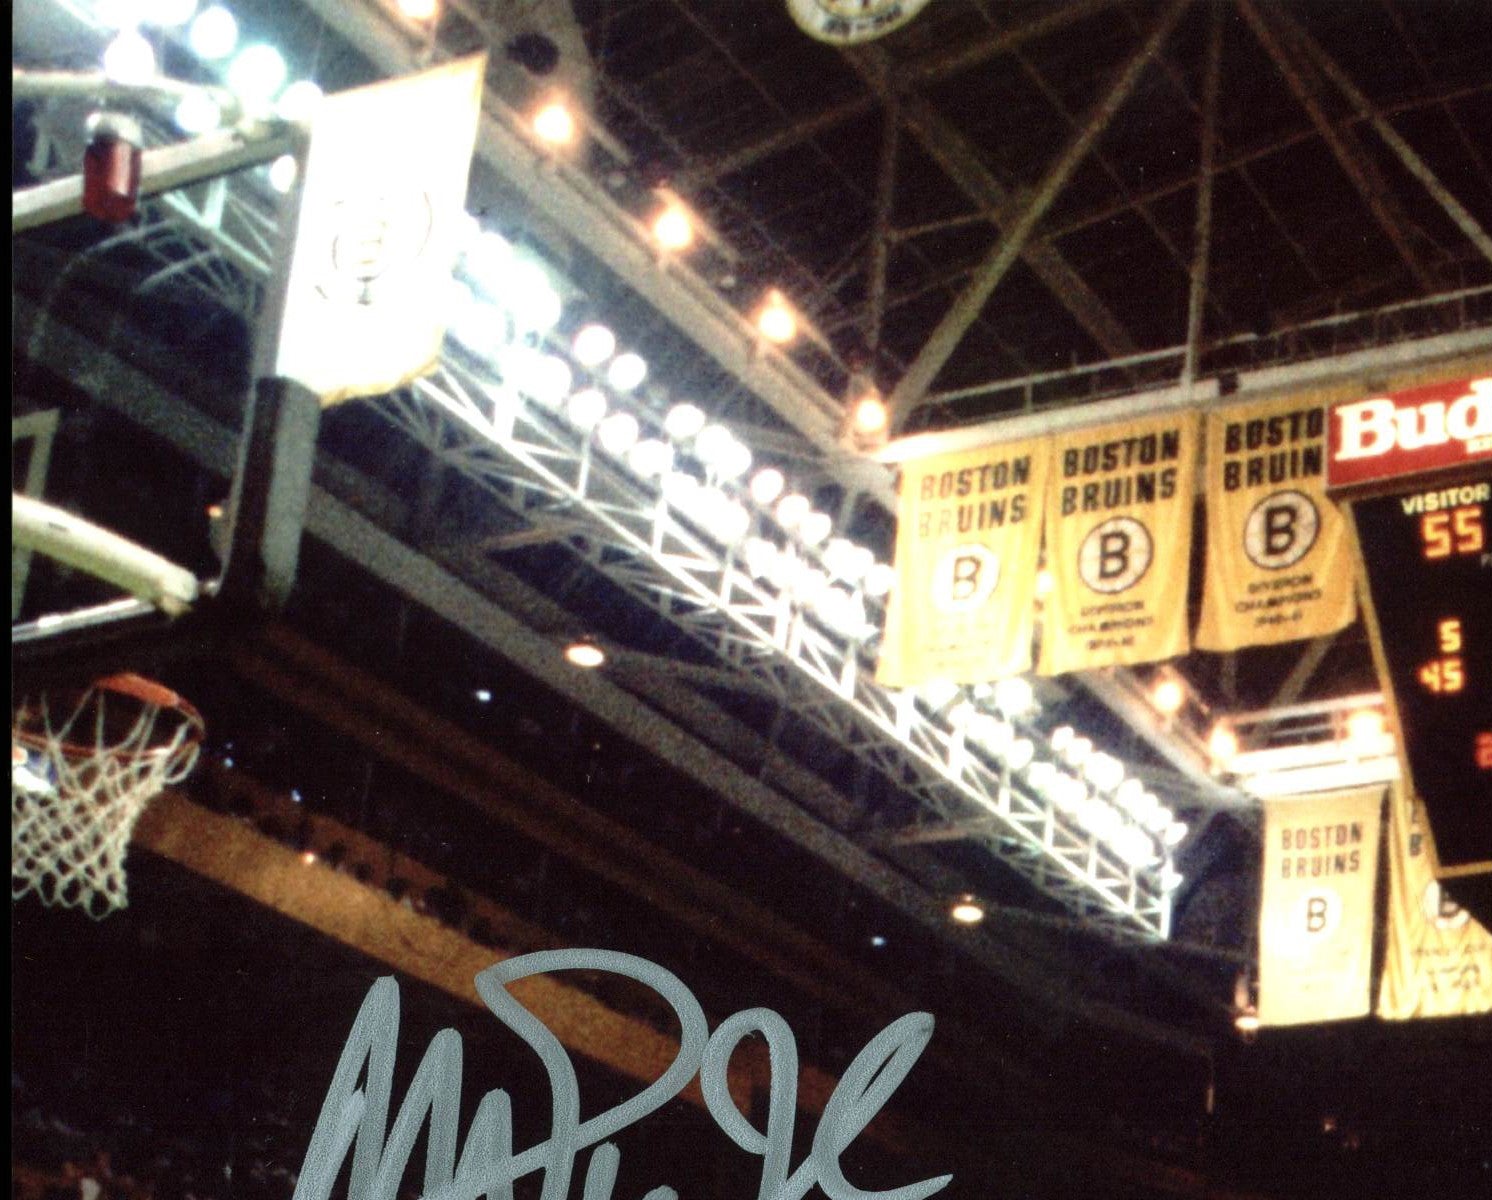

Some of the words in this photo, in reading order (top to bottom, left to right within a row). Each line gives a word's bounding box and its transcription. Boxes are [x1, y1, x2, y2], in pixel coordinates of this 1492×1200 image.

[1225, 408, 1324, 454] BOSTO
[1063, 429, 1180, 478] BOSTON
[1224, 446, 1321, 492] BRUIN
[921, 457, 1031, 498] BOSTON
[1061, 468, 1178, 517] BRUINS
[1401, 482, 1491, 516] VISITOR
[920, 494, 1027, 538] BRUINS
[1263, 504, 1298, 559] B
[1420, 508, 1483, 559] 55
[1099, 530, 1130, 579] B
[952, 555, 981, 600] B
[1438, 619, 1461, 653] 5
[1418, 657, 1465, 693] 45
[1282, 821, 1363, 850] BOSTON
[1281, 850, 1361, 880] BRUINS
[1307, 897, 1328, 932] B
